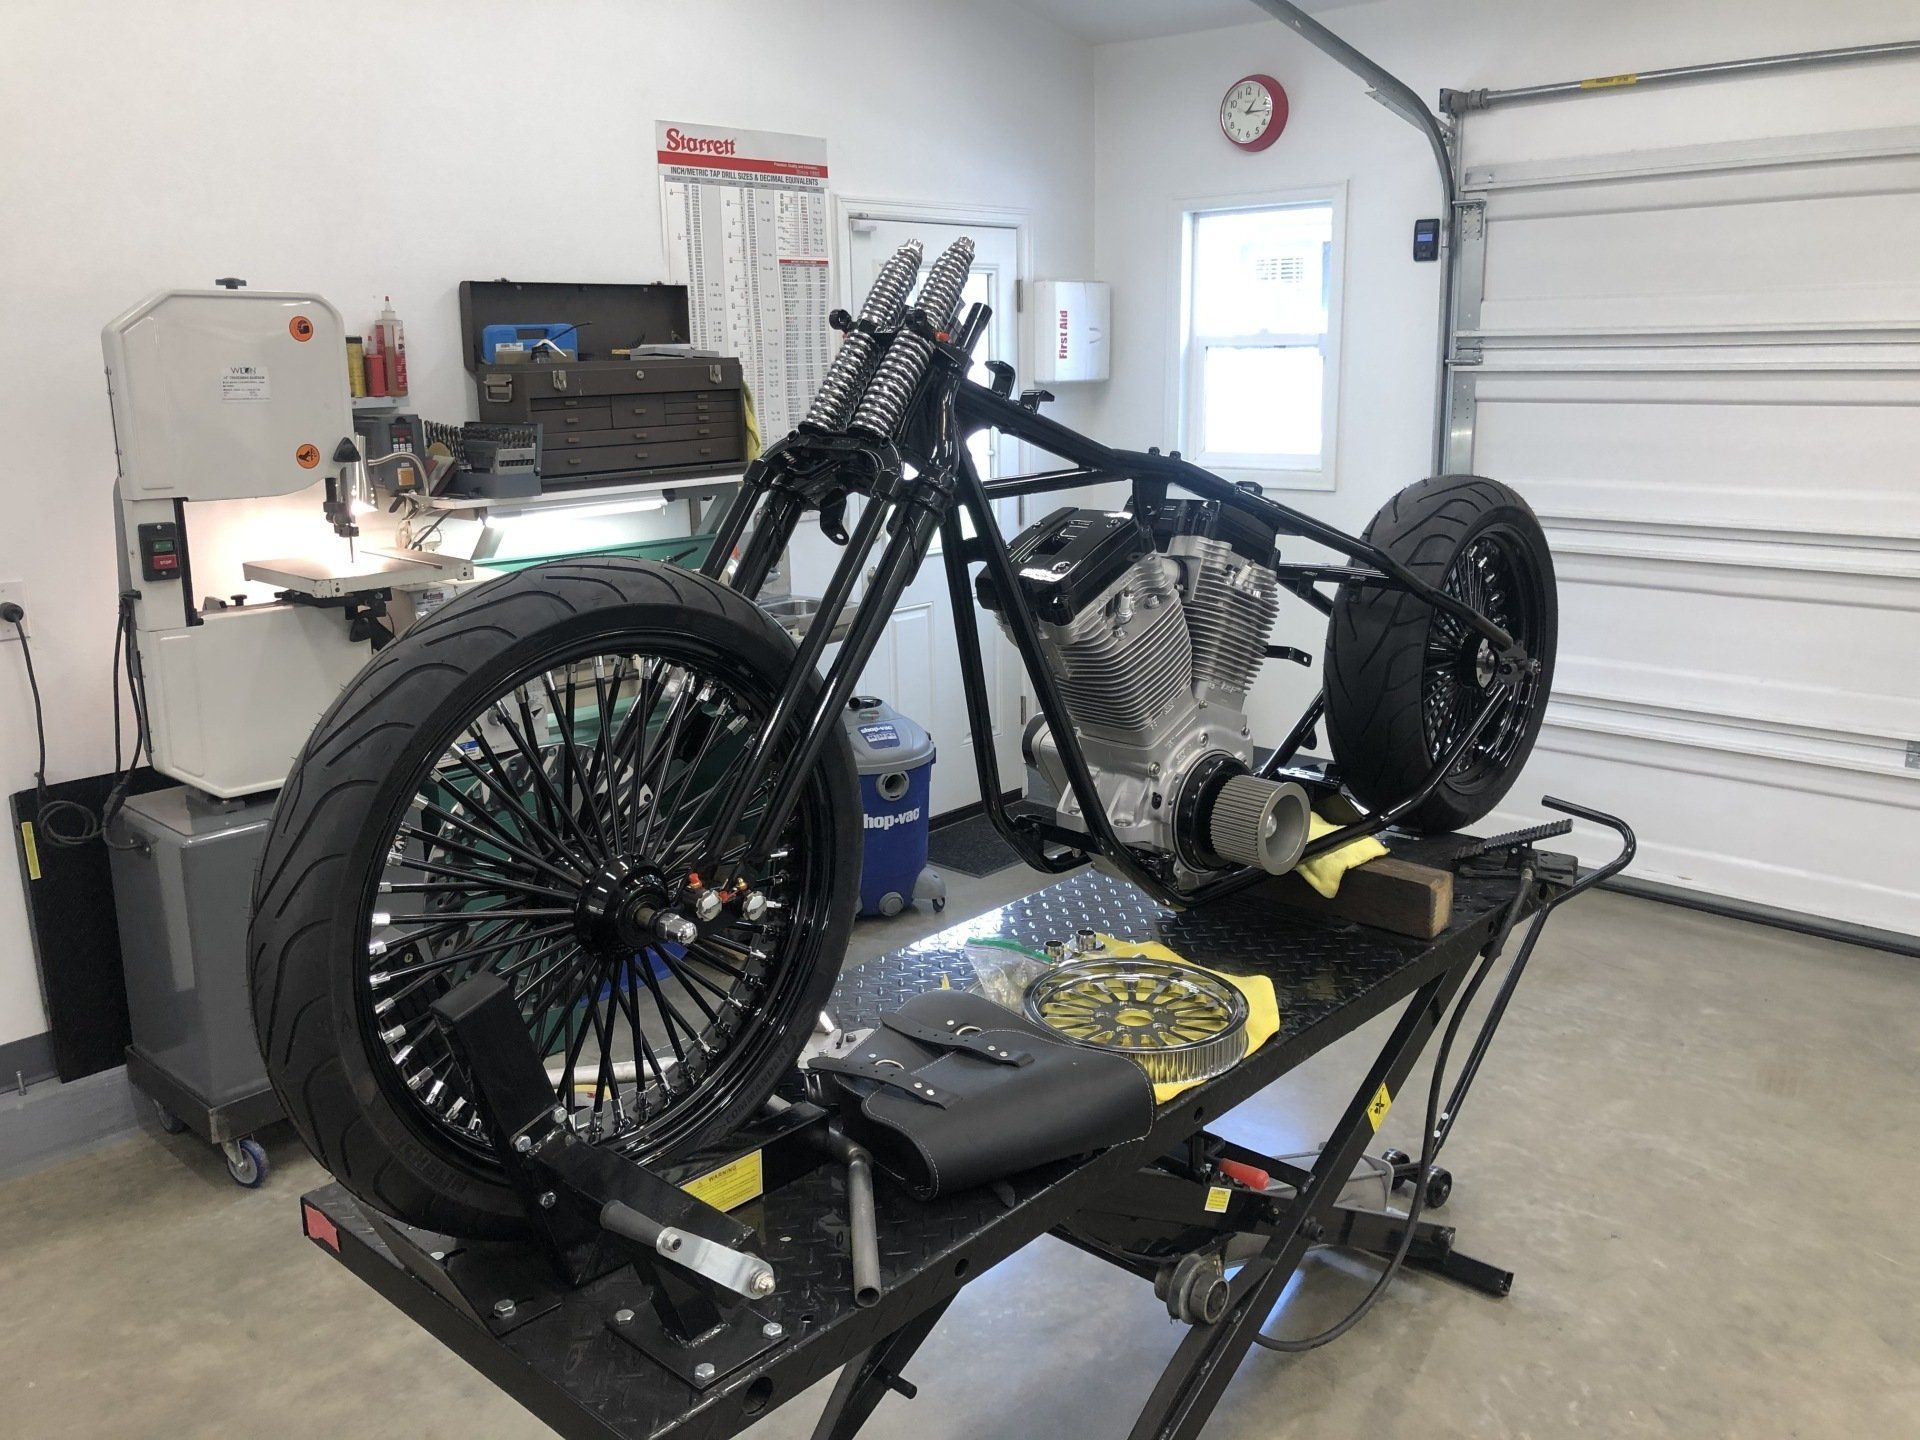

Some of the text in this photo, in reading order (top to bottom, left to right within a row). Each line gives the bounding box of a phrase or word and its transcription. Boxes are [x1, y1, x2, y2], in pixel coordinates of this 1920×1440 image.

[1237, 91, 1242, 99] 11
[1245, 86, 1252, 96] 12
[1230, 100, 1237, 108] 10
[666, 128, 735, 155] Starrett
[670, 166, 709, 176] INCH/METRIC
[710, 170, 720, 178] TAP
[722, 171, 736, 179] DRILL
[738, 172, 753, 180] SIZES
[760, 174, 785, 183] DECIMAL
[785, 177, 818, 186] EQUIVALENTS
[1059, 310, 1068, 359] First Aid
[709, 1164, 737, 1181] WARNING
